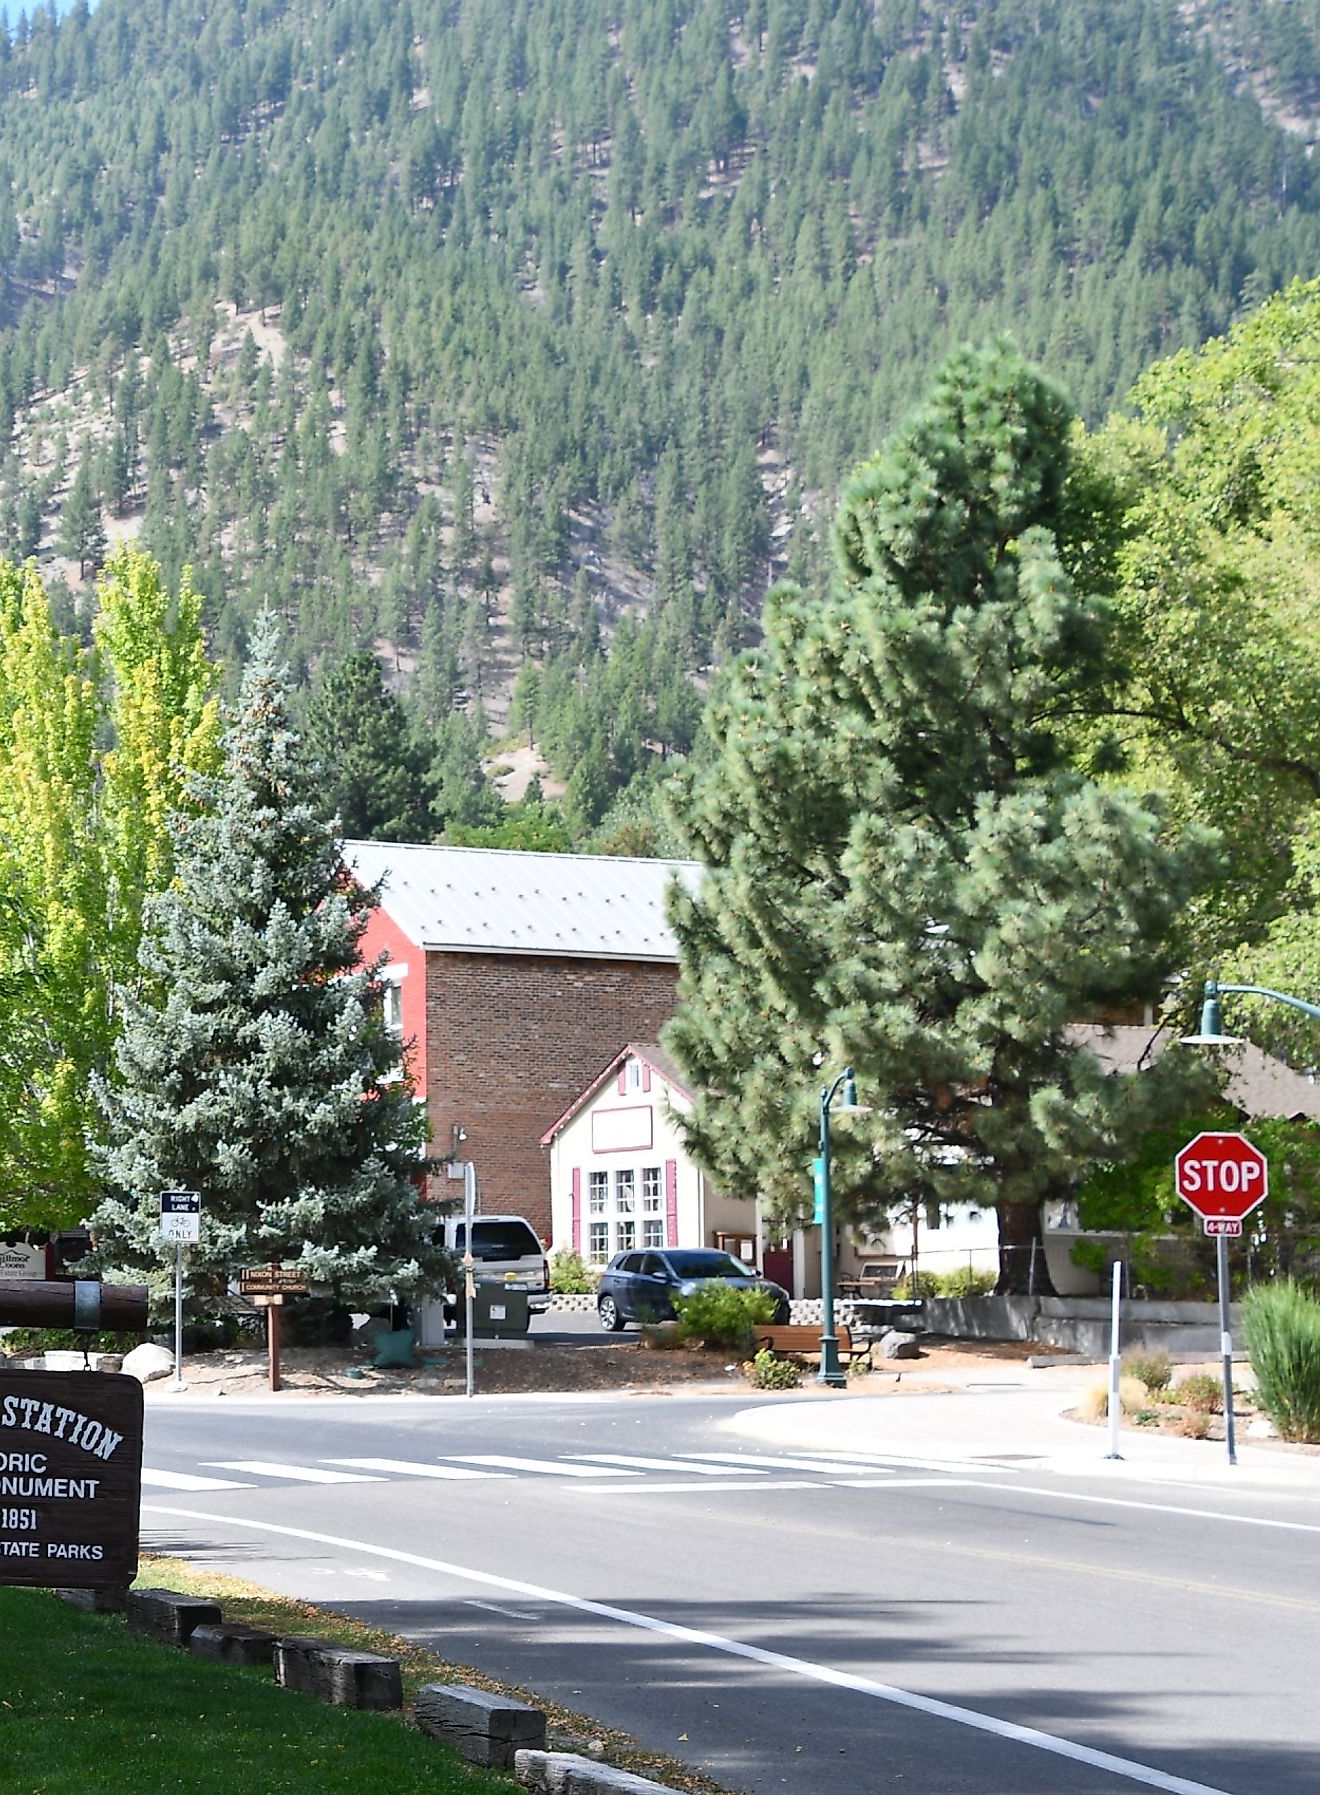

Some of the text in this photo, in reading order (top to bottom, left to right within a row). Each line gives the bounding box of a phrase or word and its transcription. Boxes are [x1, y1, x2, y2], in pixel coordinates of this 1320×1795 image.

[1182, 1160, 1260, 1192] STOP
[171, 1203, 190, 1211] LANE
[1208, 1222, 1239, 1233] 4-WAY
[169, 1230, 192, 1239] ONLY
[274, 1270, 302, 1278] STREET
[1, 1395, 124, 1461] STATION
[47, 1543, 104, 1560] PARKS
